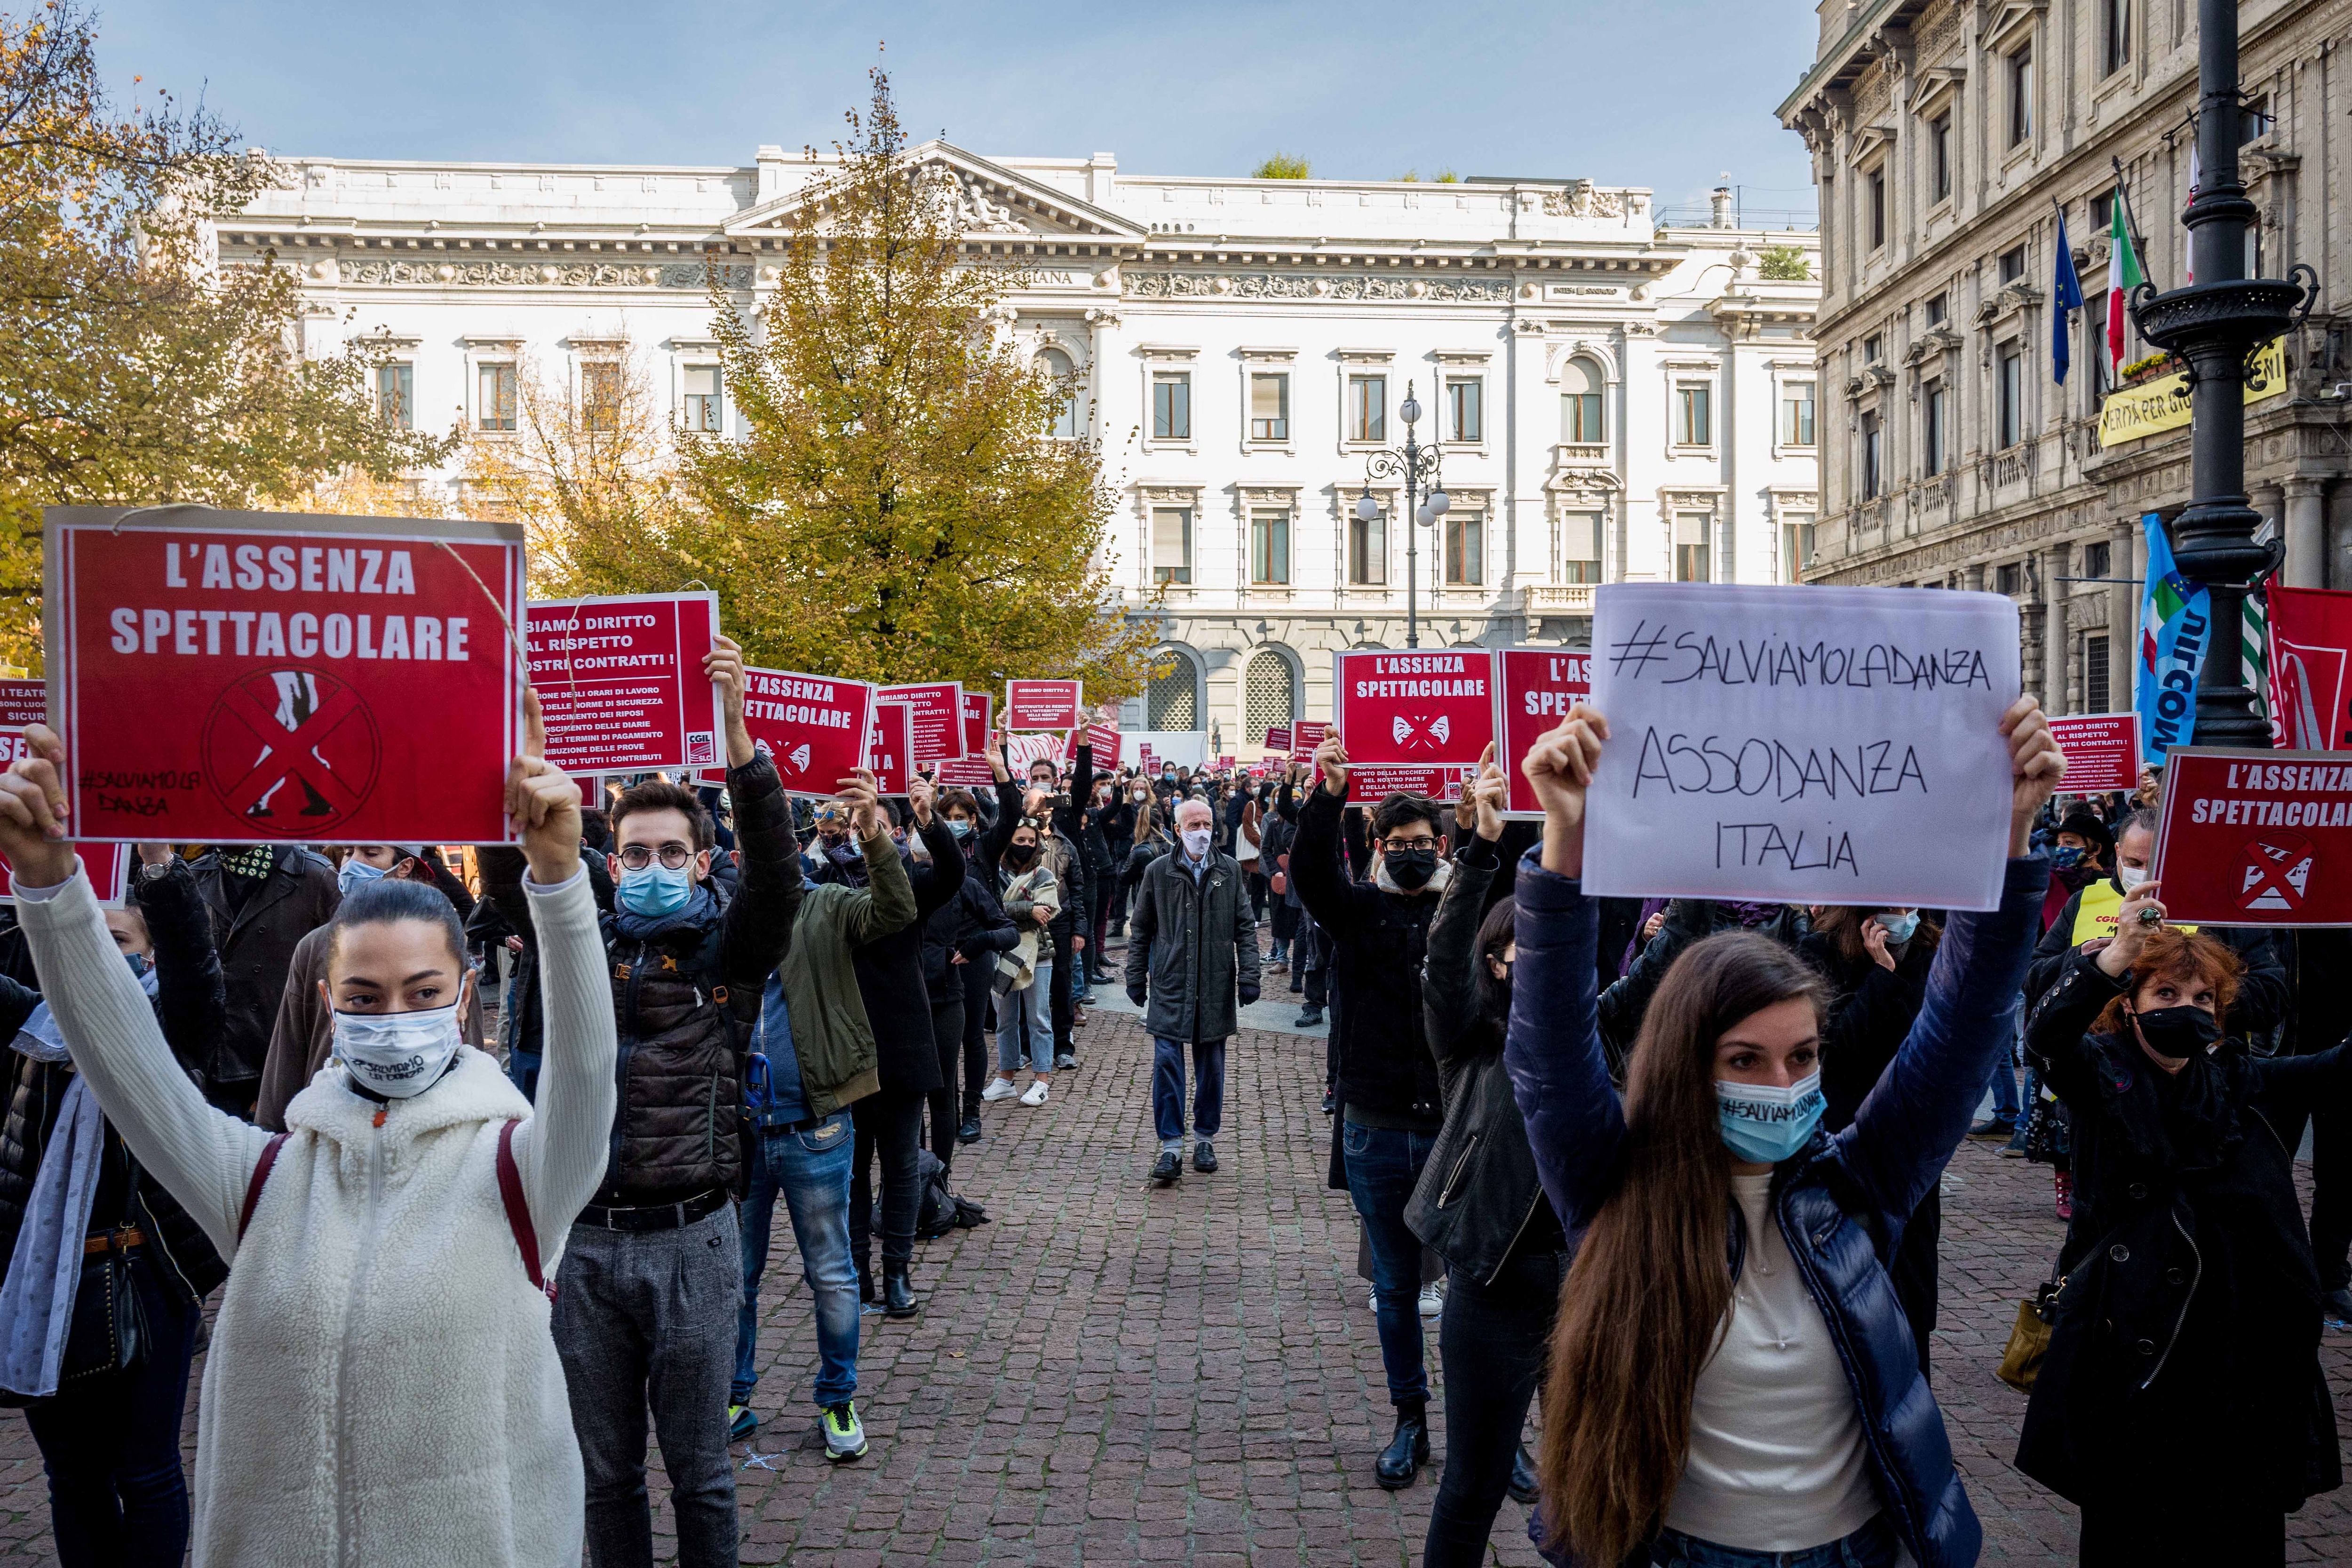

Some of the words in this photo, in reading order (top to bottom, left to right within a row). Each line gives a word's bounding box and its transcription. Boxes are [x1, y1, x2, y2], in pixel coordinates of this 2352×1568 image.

[2142, 395, 2166, 422] PER
[166, 542, 416, 595] L'ASSENZA
[586, 615, 656, 629] DIRITTO
[111, 607, 469, 661] SPETTACOLARE
[548, 635, 633, 651] RISPETTO
[574, 654, 664, 669] CONTRATTI
[1376, 657, 1464, 674] L'ASSENZA
[745, 675, 834, 702] L'ASSENZA
[1357, 679, 1485, 698] SPETTACOLARE
[742, 700, 851, 729] ETTACOLARE
[612, 732, 663, 740] PAGAMENTO
[611, 754, 662, 762] CONTRIBUTI
[1634, 726, 1927, 803] ASSODANZA
[2227, 764, 2352, 791] L'ASSENZA
